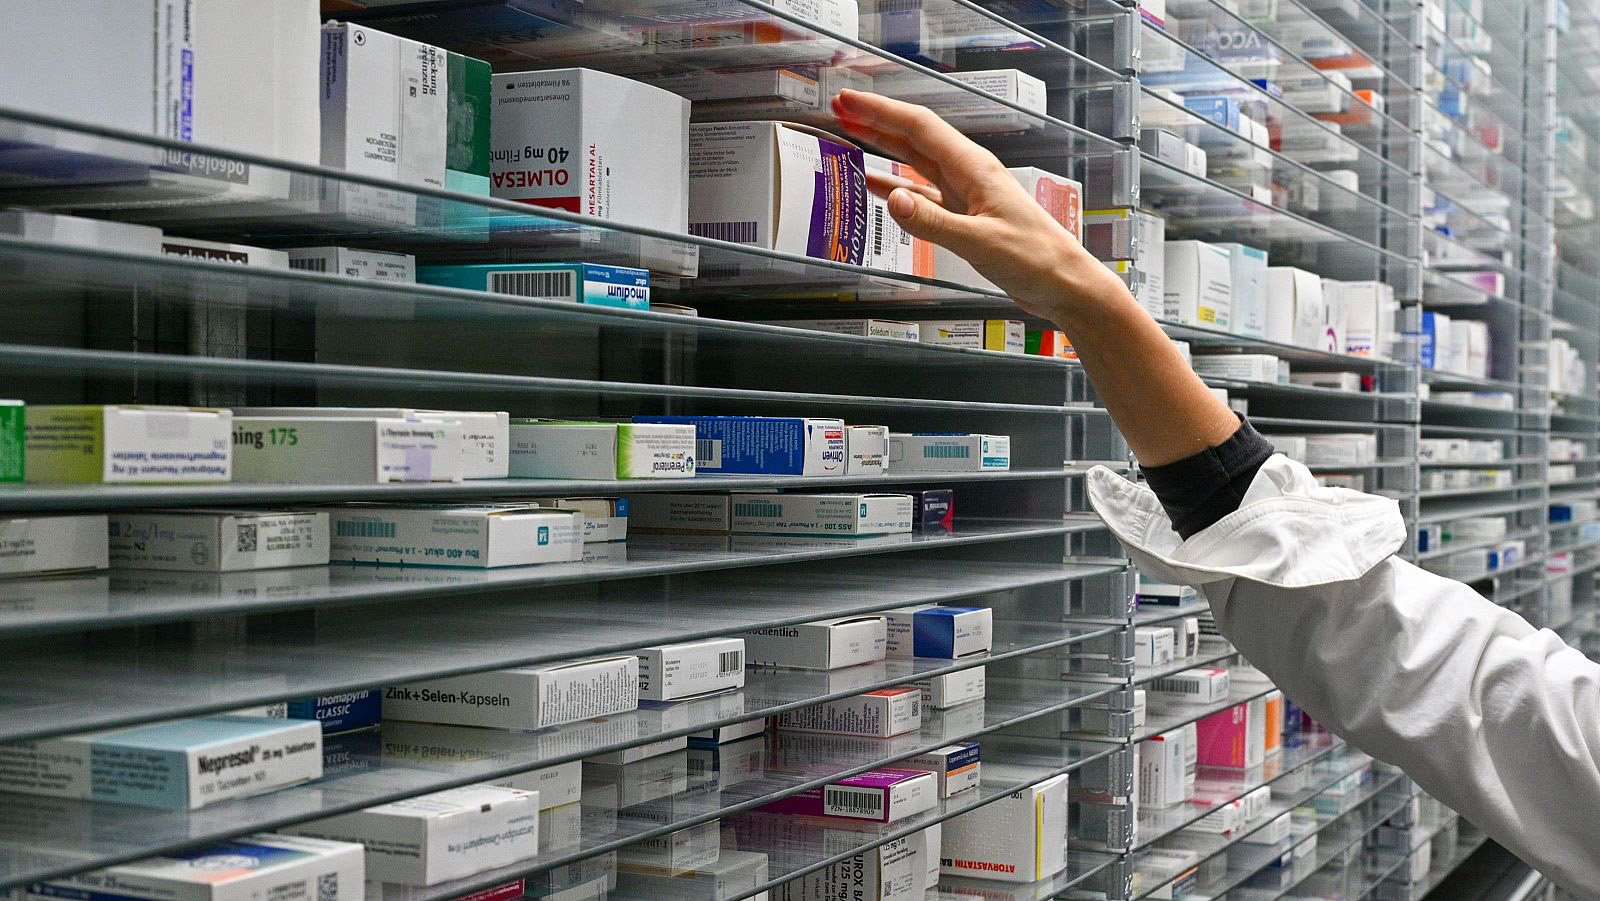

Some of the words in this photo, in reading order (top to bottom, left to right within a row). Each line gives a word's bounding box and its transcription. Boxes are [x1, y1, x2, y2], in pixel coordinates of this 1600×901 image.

[517, 80, 561, 89] Filmtabletten
[560, 79, 570, 87] 98
[498, 93, 570, 106] Olmesartanmedoxomil
[524, 147, 544, 160] mg
[548, 148, 570, 164] 40
[590, 143, 596, 158] AL
[841, 153, 851, 241] Schwangerschaft
[835, 243, 849, 264] 2
[607, 284, 648, 302] Imodium
[905, 330, 918, 340] forte
[269, 427, 299, 447] 175
[822, 450, 844, 463] Otriven
[652, 461, 686, 473] Perenterol
[836, 523, 853, 531] ASS
[424, 547, 445, 558] akut
[446, 548, 463, 559] 400
[465, 549, 480, 560] Ibu
[747, 626, 799, 638] chentlich
[385, 687, 511, 708] Zink+Selen-Kapseln
[315, 704, 352, 720] CLASSIC
[841, 860, 851, 879] 125
[954, 859, 1016, 874] ATORVASTATIN
